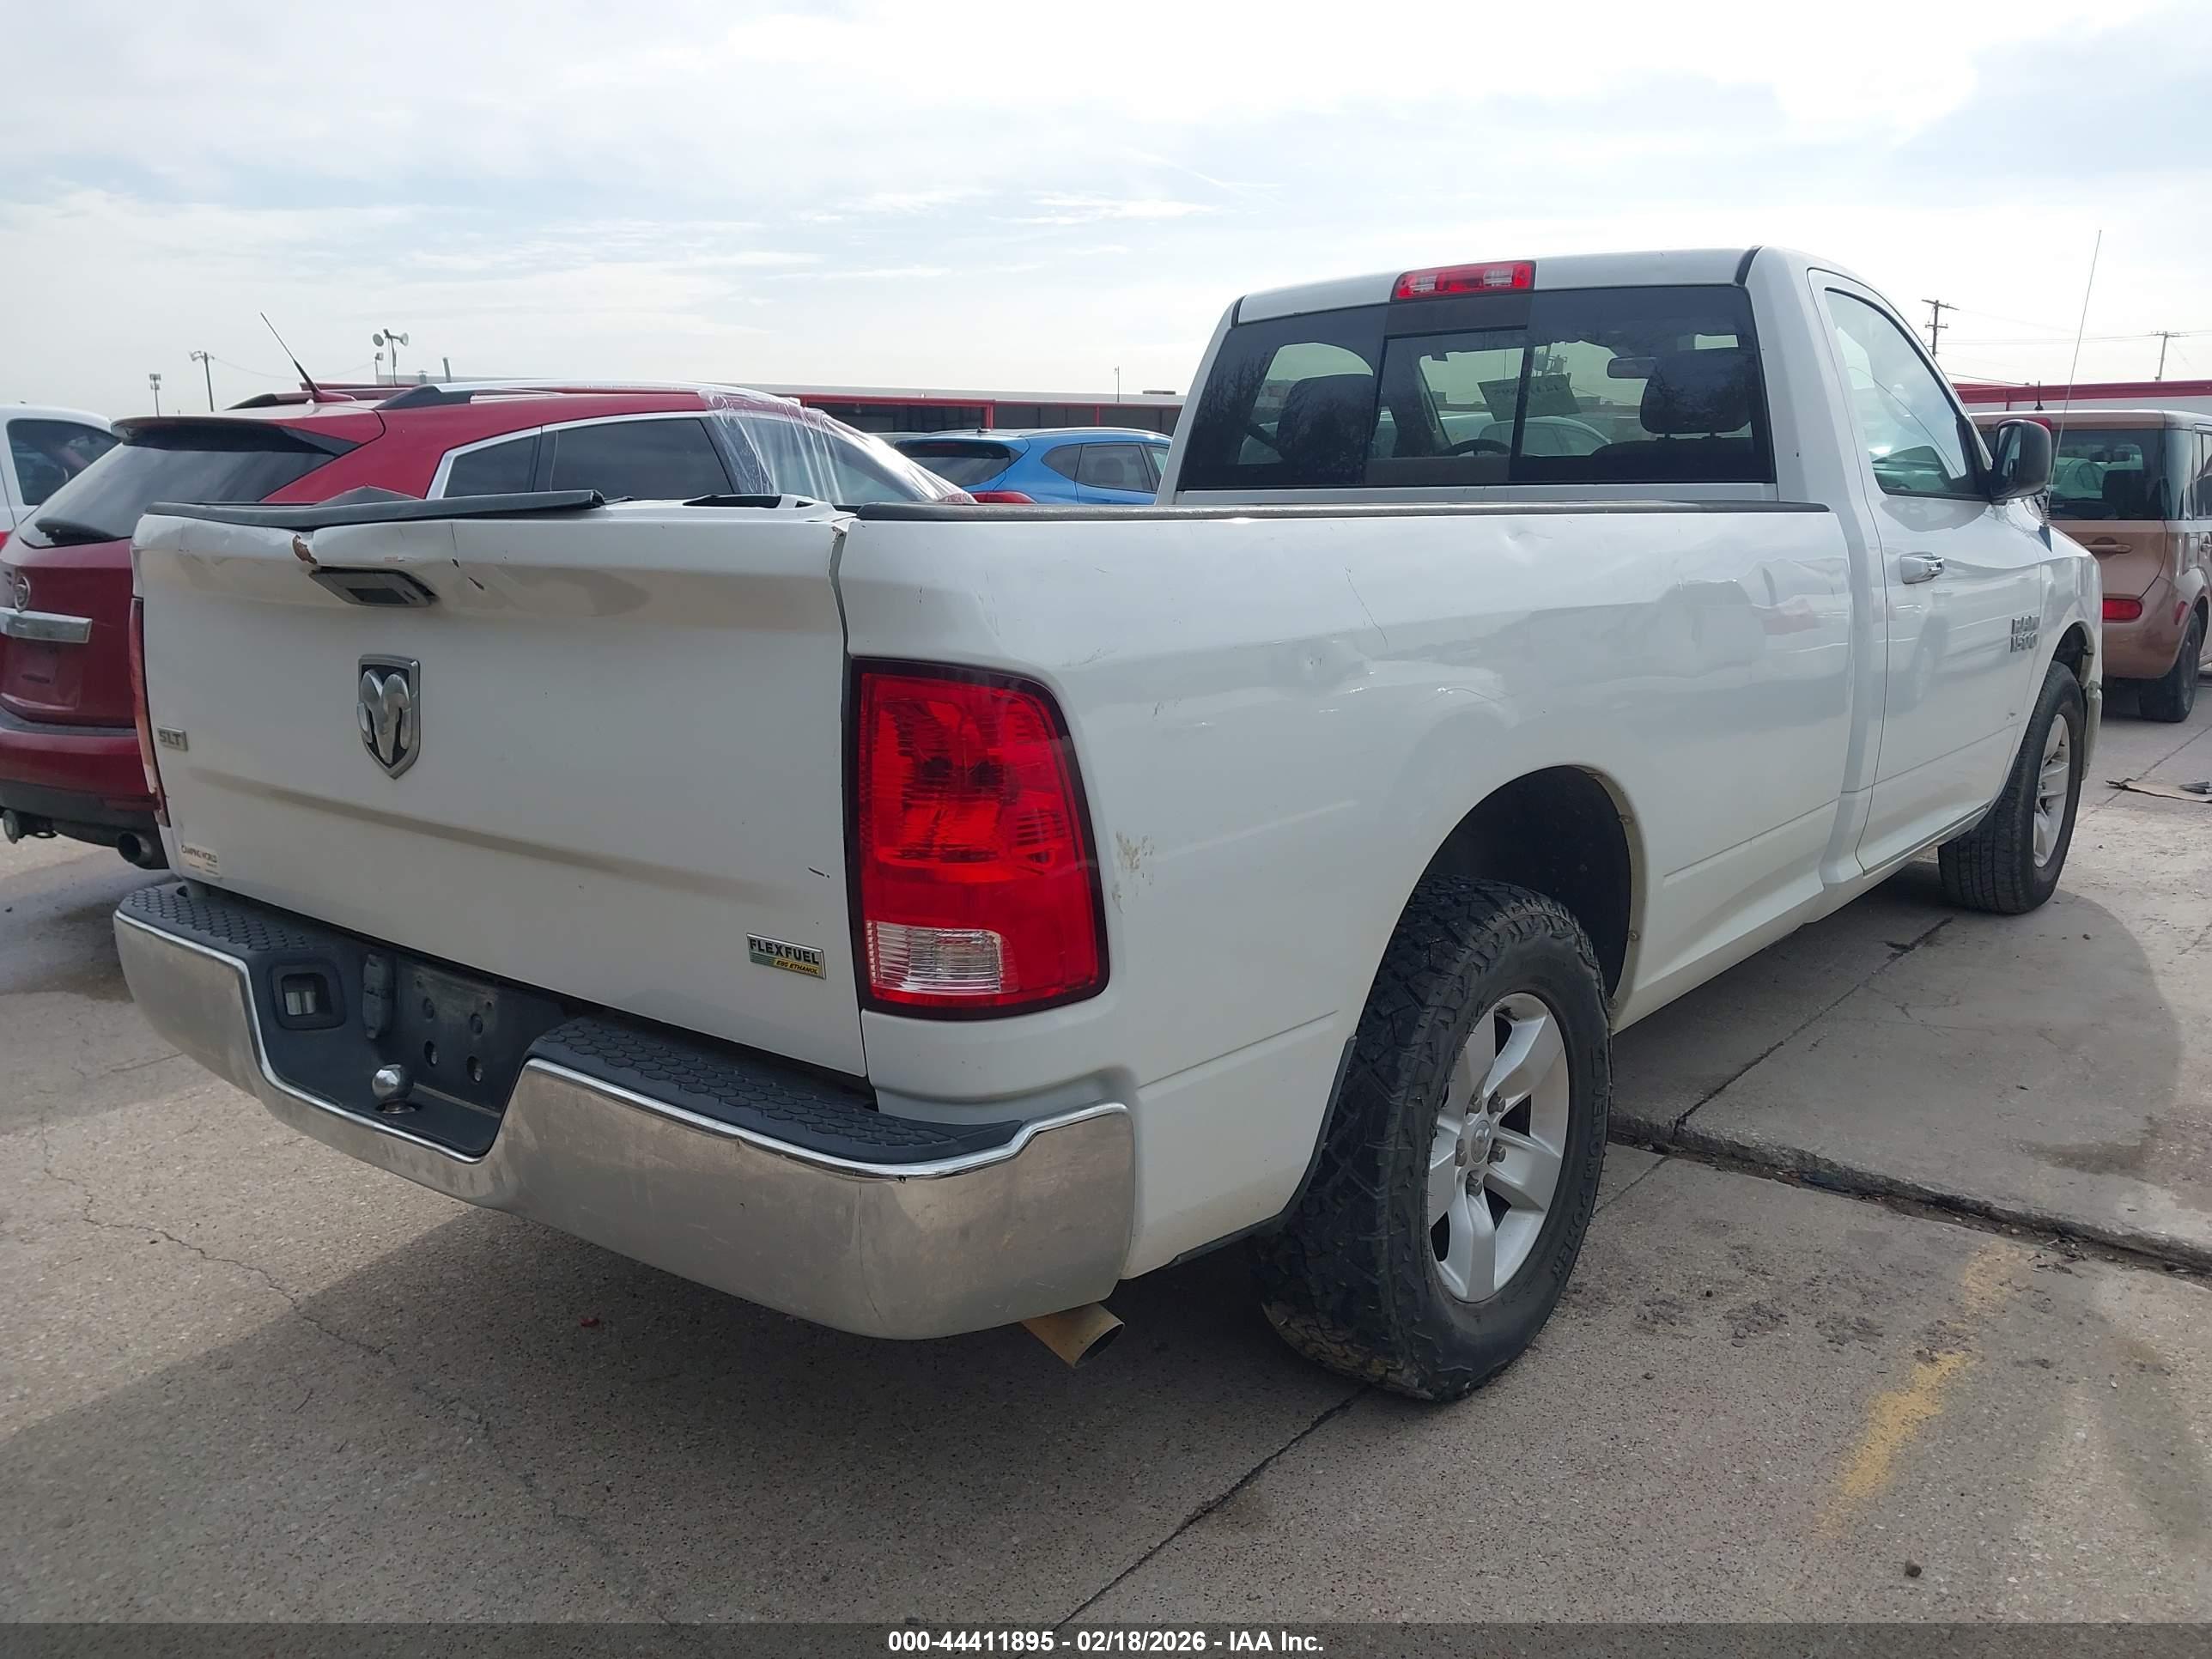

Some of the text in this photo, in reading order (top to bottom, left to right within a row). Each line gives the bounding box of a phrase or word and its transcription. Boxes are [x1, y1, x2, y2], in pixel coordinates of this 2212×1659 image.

[158, 730, 181, 746] SLT
[749, 939, 819, 964] FLEXFUEL
[789, 962, 818, 975] ETHANOL
[1552, 1085, 1607, 1283] VENOM POWER
